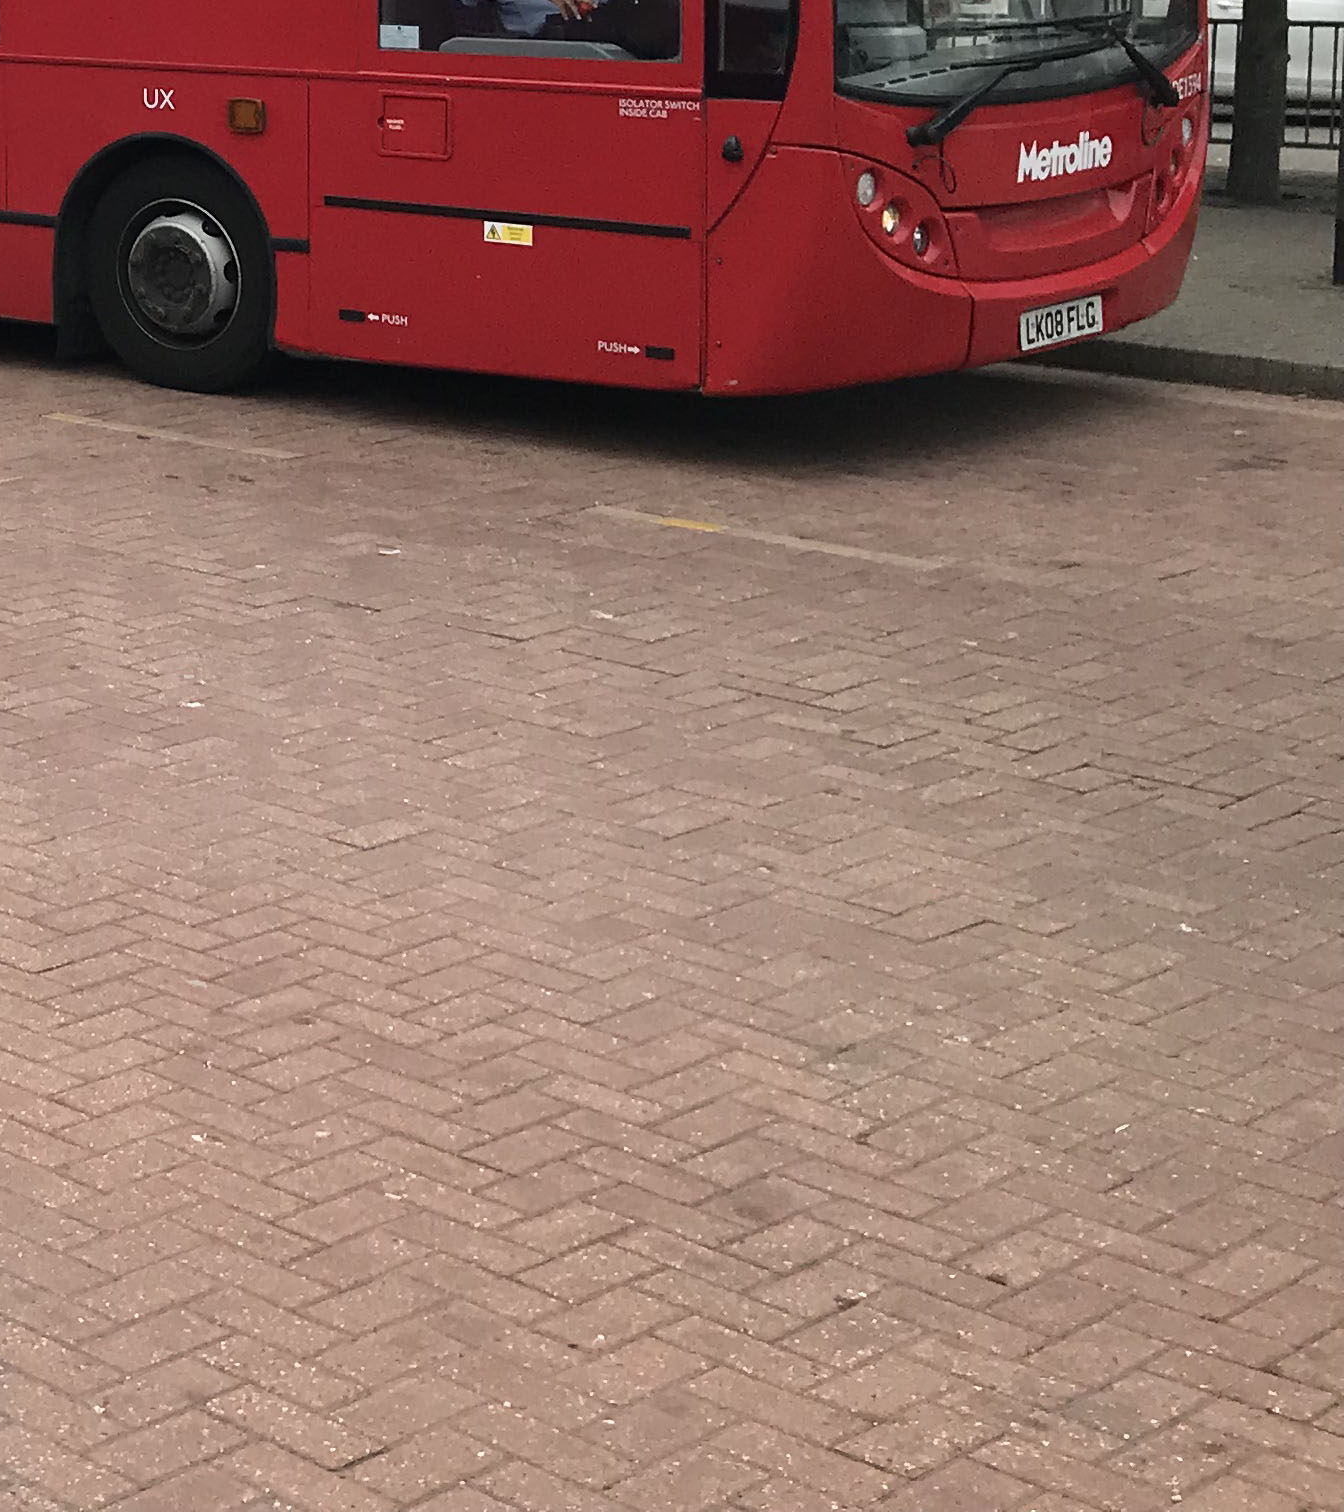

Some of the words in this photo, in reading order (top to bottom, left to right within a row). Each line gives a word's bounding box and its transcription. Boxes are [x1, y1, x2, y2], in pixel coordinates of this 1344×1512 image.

[142, 88, 176, 111] UX
[618, 99, 663, 109] ISOLATOR
[664, 101, 700, 111] SWITCH
[618, 108, 648, 118] INSIDE
[648, 109, 668, 119] CAB
[1017, 131, 1113, 184] Metroline
[381, 313, 408, 326] PUSH
[1026, 306, 1065, 346] LK08
[1066, 299, 1098, 335] FLG
[597, 340, 627, 354] PUSH
